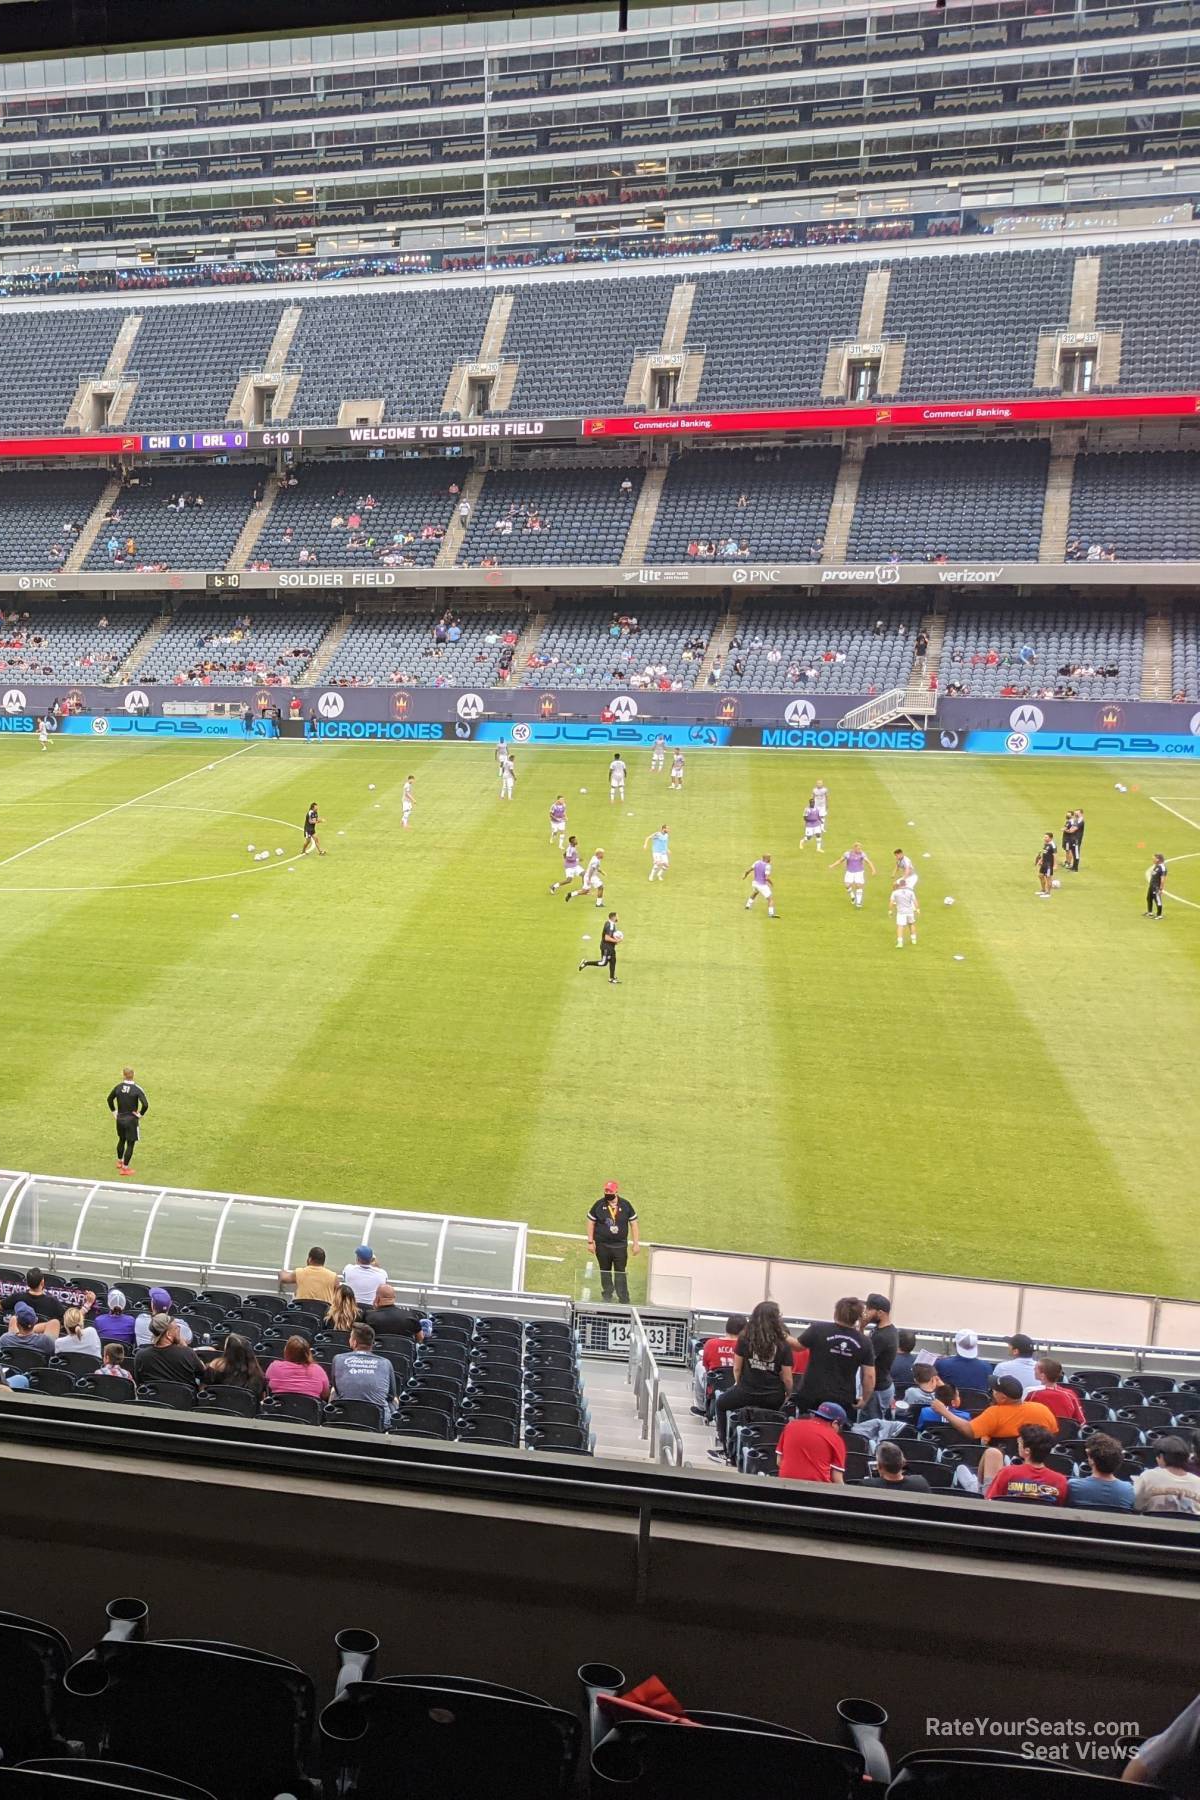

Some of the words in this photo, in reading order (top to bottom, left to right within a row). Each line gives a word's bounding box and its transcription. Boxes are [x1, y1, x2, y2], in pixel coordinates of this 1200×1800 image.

[923, 408, 974, 419] Commercial
[350, 427, 415, 441] WELCOME
[420, 426, 437, 438] TO
[442, 424, 501, 438] SOLDIER
[504, 422, 544, 436] FIELD
[633, 420, 678, 430] Commercial
[149, 436, 170, 448] CHI
[178, 436, 186, 448] 0
[202, 434, 226, 447] ORL
[234, 433, 242, 446] 0
[262, 432, 289, 445] 6:10
[214, 575, 239, 587] 6:10
[279, 574, 343, 586] SOLDIER
[353, 573, 395, 585] FIELD
[638, 569, 661, 583] Lite
[750, 570, 780, 582] PNC
[821, 568, 874, 582] proven
[938, 569, 995, 582] verizon
[32, 578, 56, 588] PNC
[304, 720, 443, 739] MICROPHONES
[762, 729, 925, 749] MICROPHONES
